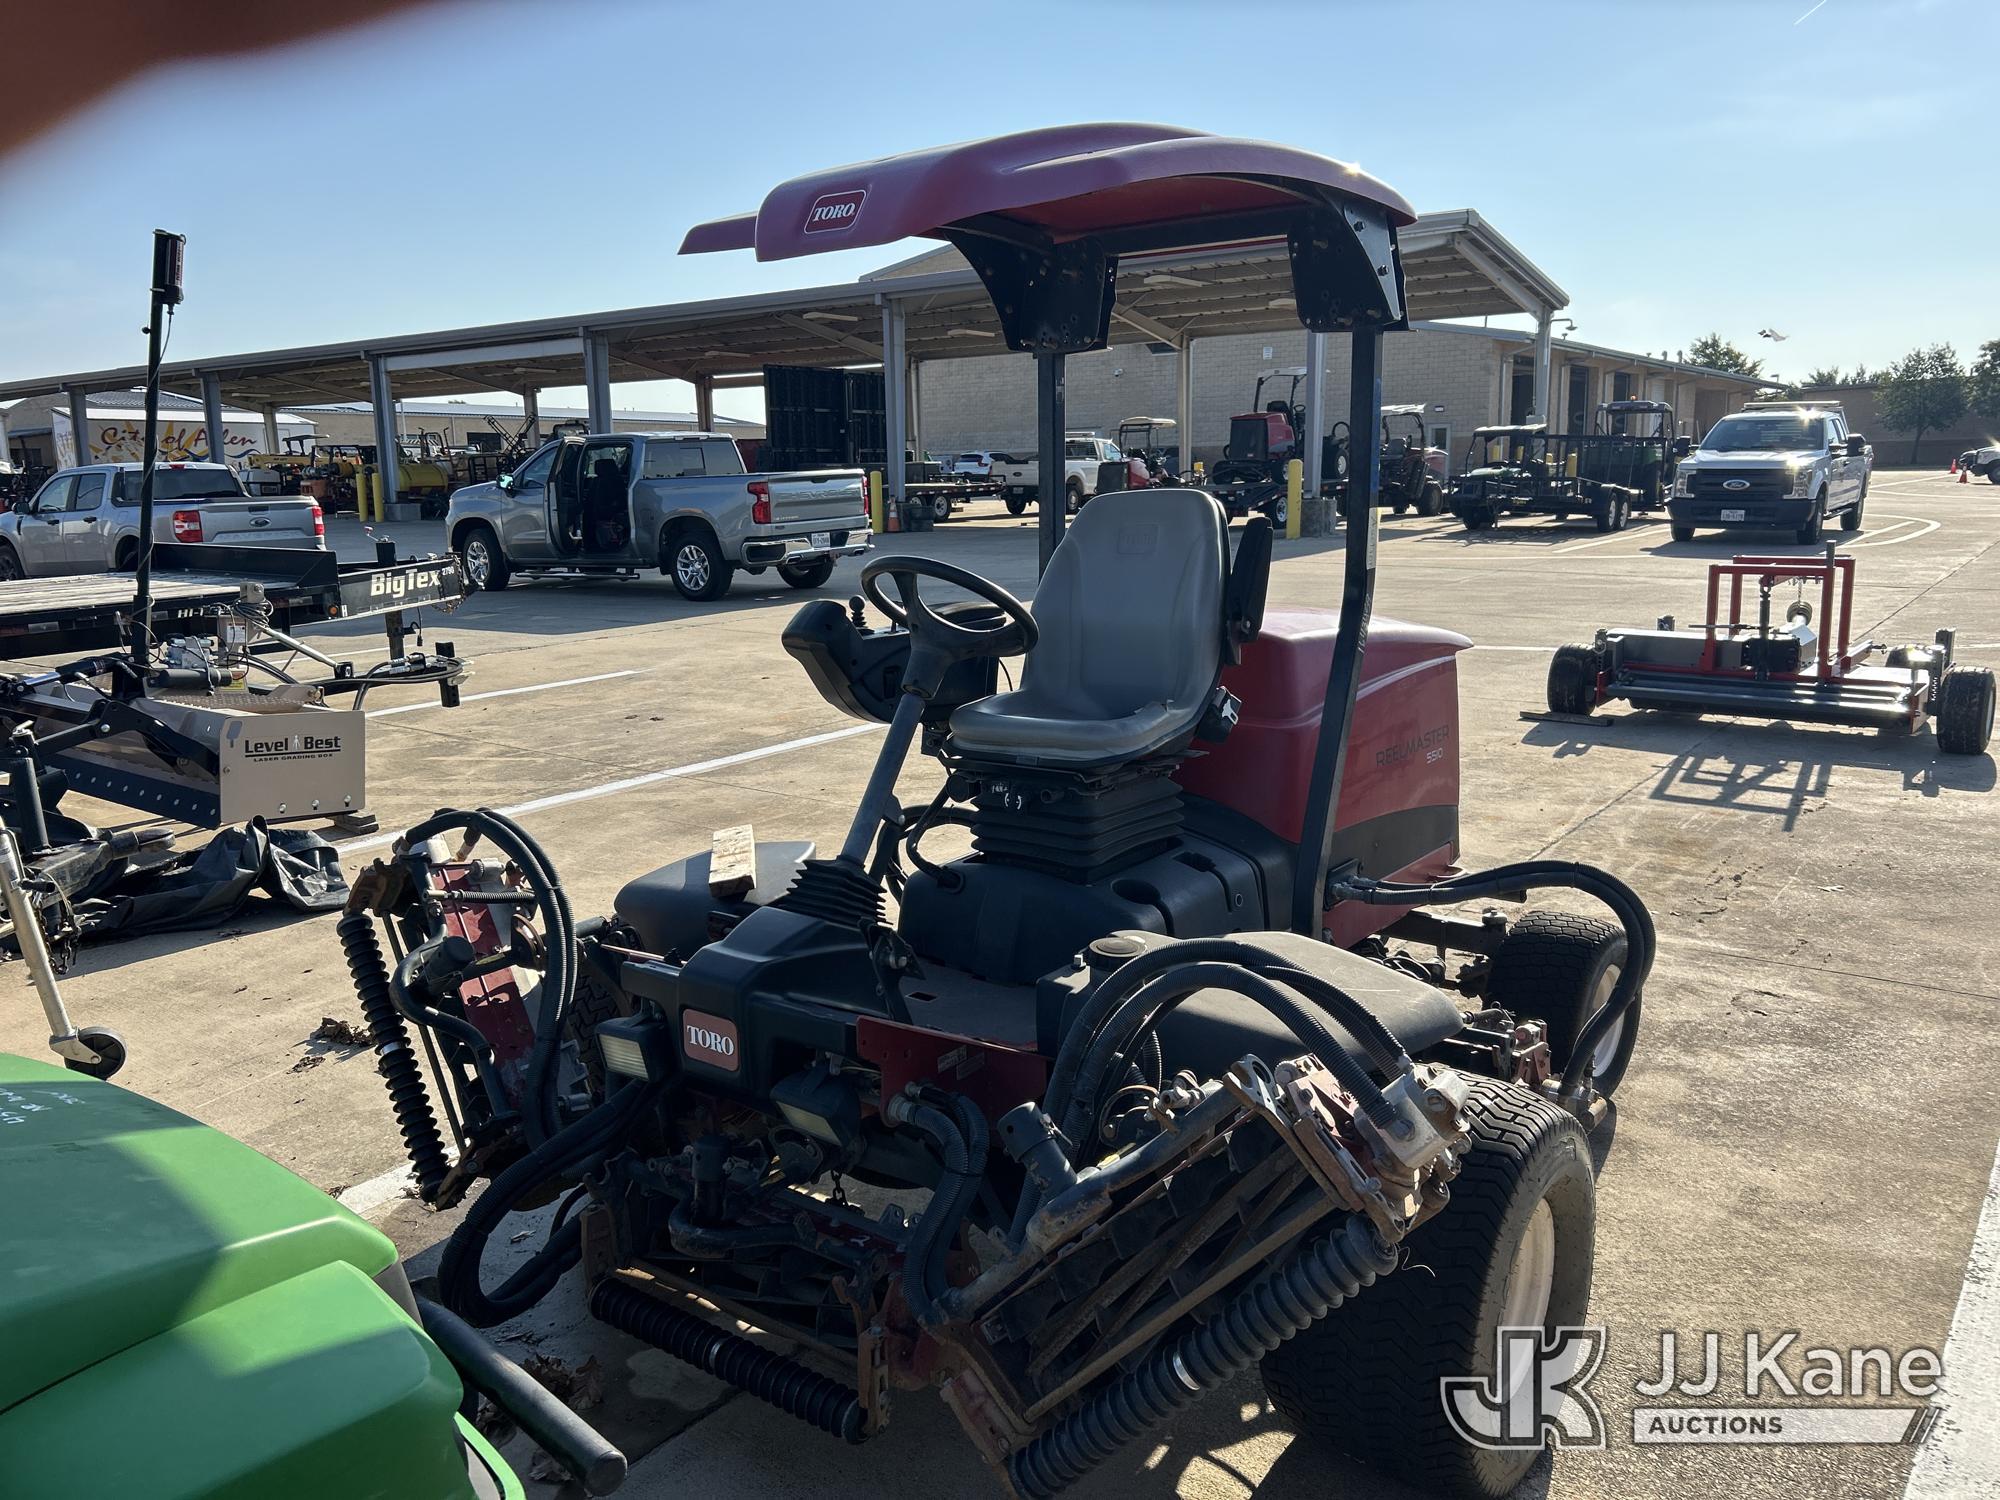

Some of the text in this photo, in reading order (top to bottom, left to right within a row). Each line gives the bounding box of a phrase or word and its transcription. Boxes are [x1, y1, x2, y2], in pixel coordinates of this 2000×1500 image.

[813, 203, 856, 222] TORO
[194, 428, 257, 447] Alen
[245, 736, 341, 753] Level Best
[1376, 725, 1449, 767] REELMASTER
[686, 1025, 735, 1056] TORO
